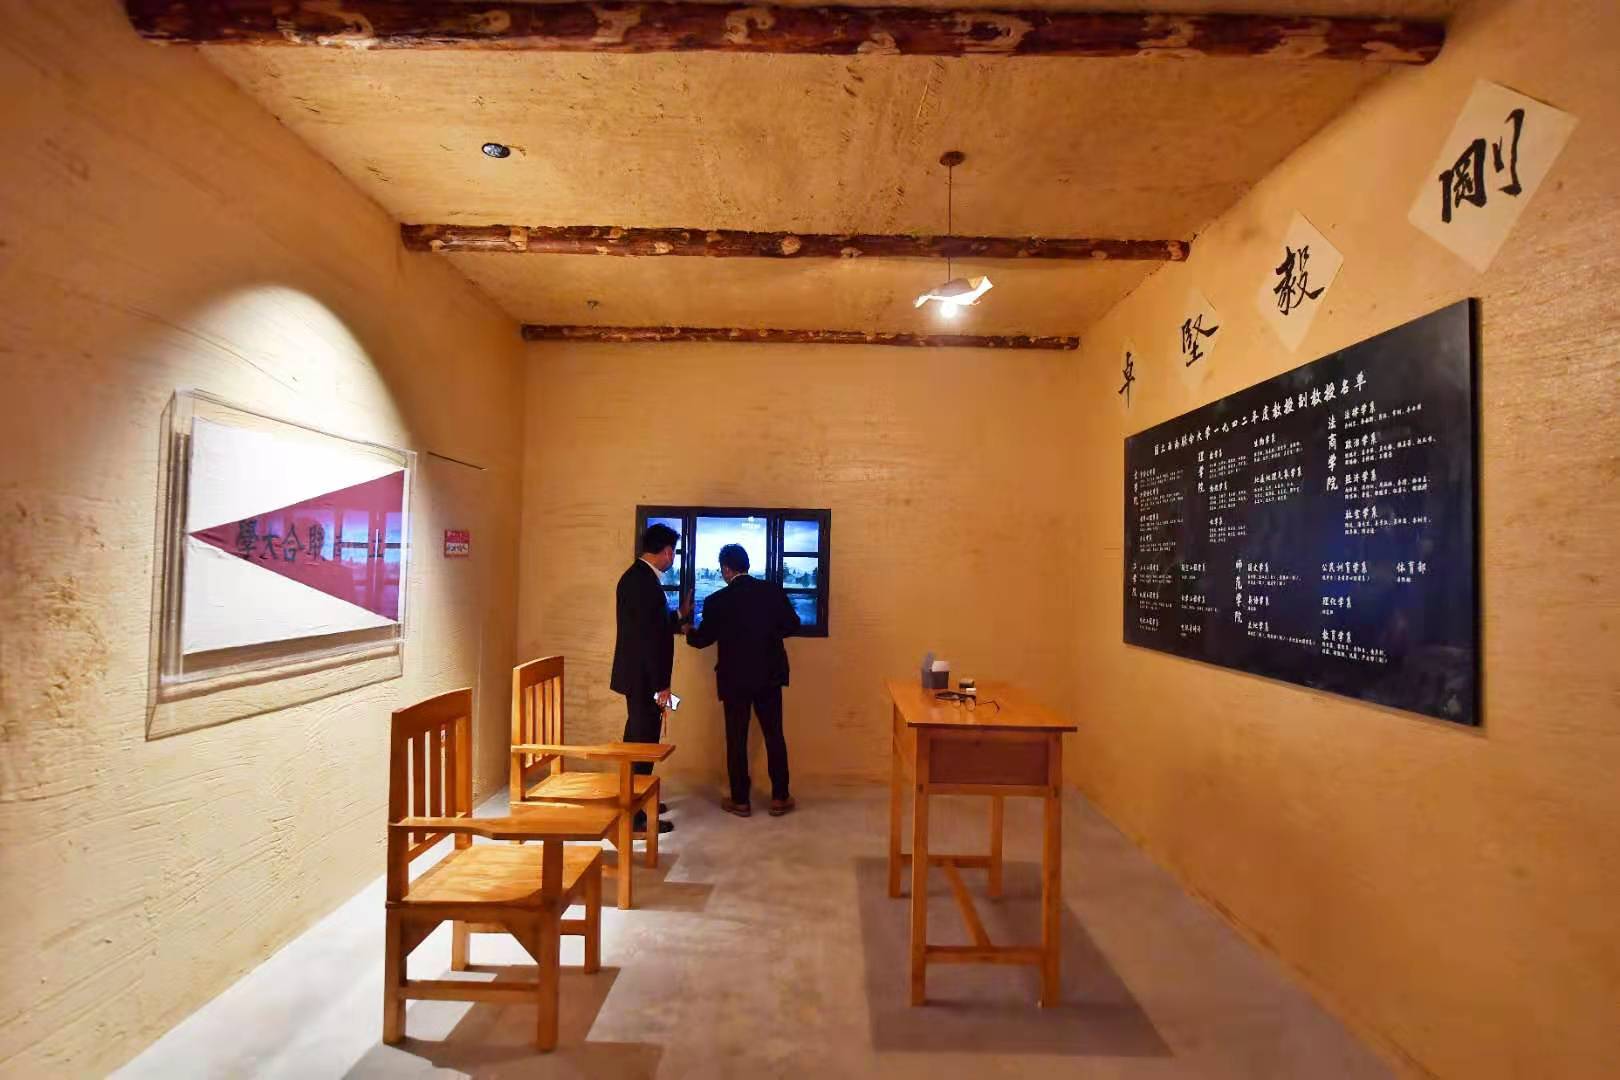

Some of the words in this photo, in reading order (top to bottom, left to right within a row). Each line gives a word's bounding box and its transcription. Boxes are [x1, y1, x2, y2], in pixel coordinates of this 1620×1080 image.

[1119, 351, 1135, 408] 卓
[1327, 414, 1338, 491] 法商学院
